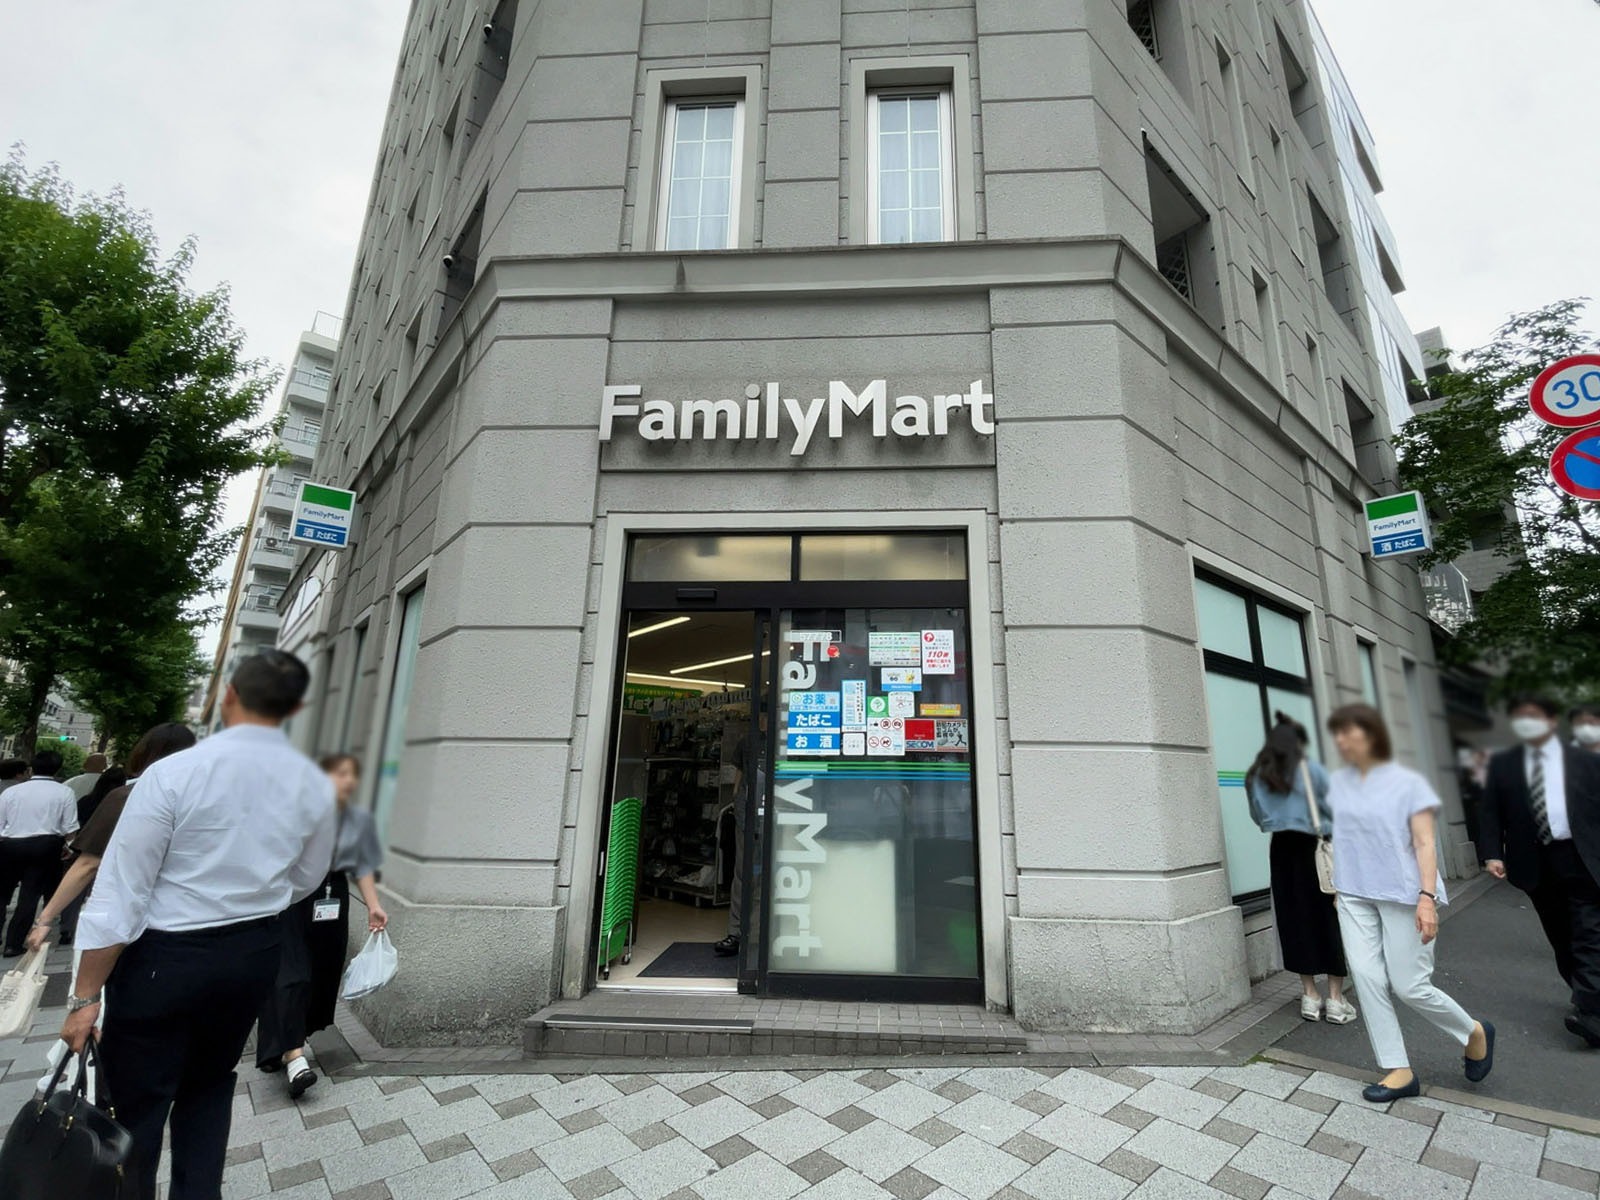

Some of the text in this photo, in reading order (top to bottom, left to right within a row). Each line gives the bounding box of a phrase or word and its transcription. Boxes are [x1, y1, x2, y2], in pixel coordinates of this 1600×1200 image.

[1552, 371, 1600, 409] 30
[599, 379, 995, 456] FamilyMart
[303, 508, 344, 520] FamilyMart
[1374, 518, 1416, 530] FamilyMart
[316, 531, 337, 541] たばこ
[1395, 538, 1416, 549] たばこ
[802, 693, 826, 705] お薬
[796, 713, 832, 726] たばこ
[906, 740, 935, 749] SECOM
